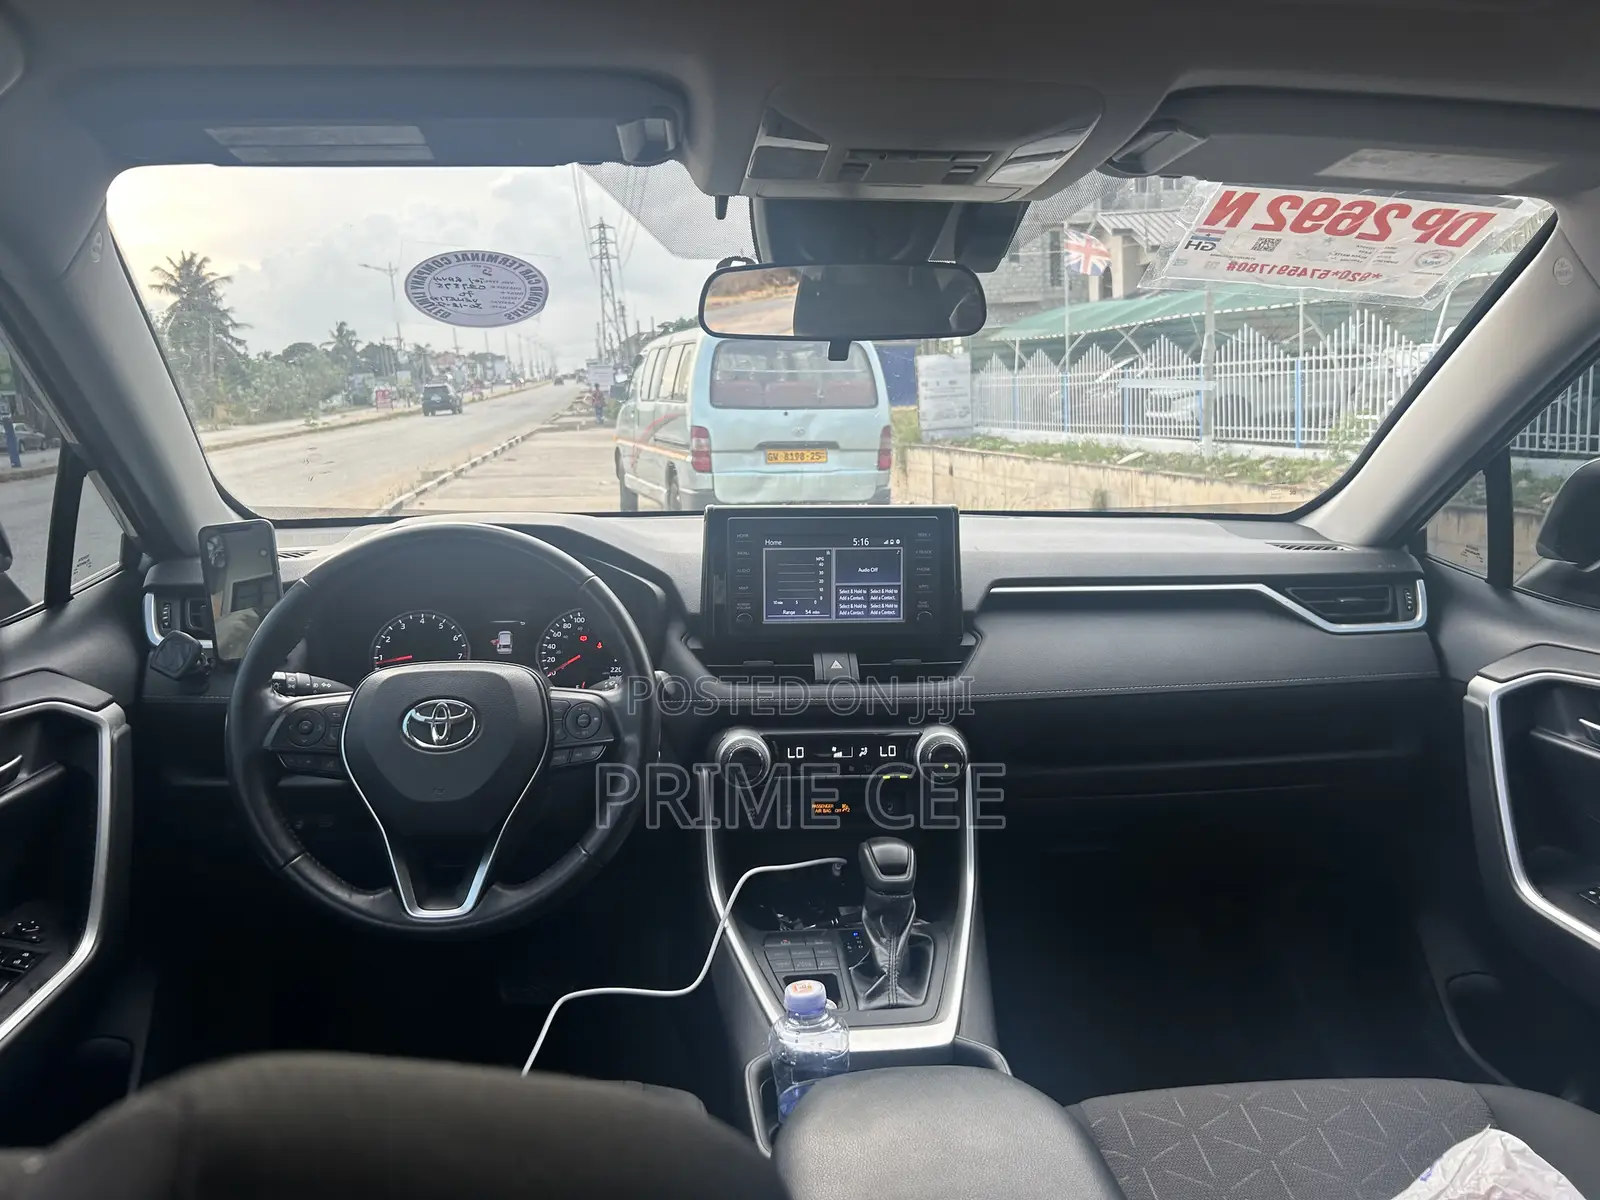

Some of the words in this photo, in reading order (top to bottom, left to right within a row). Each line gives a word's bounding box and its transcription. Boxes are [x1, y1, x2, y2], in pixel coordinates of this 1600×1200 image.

[853, 537, 870, 546] 5:16
[787, 746, 804, 759] LO
[879, 745, 896, 757] LO
